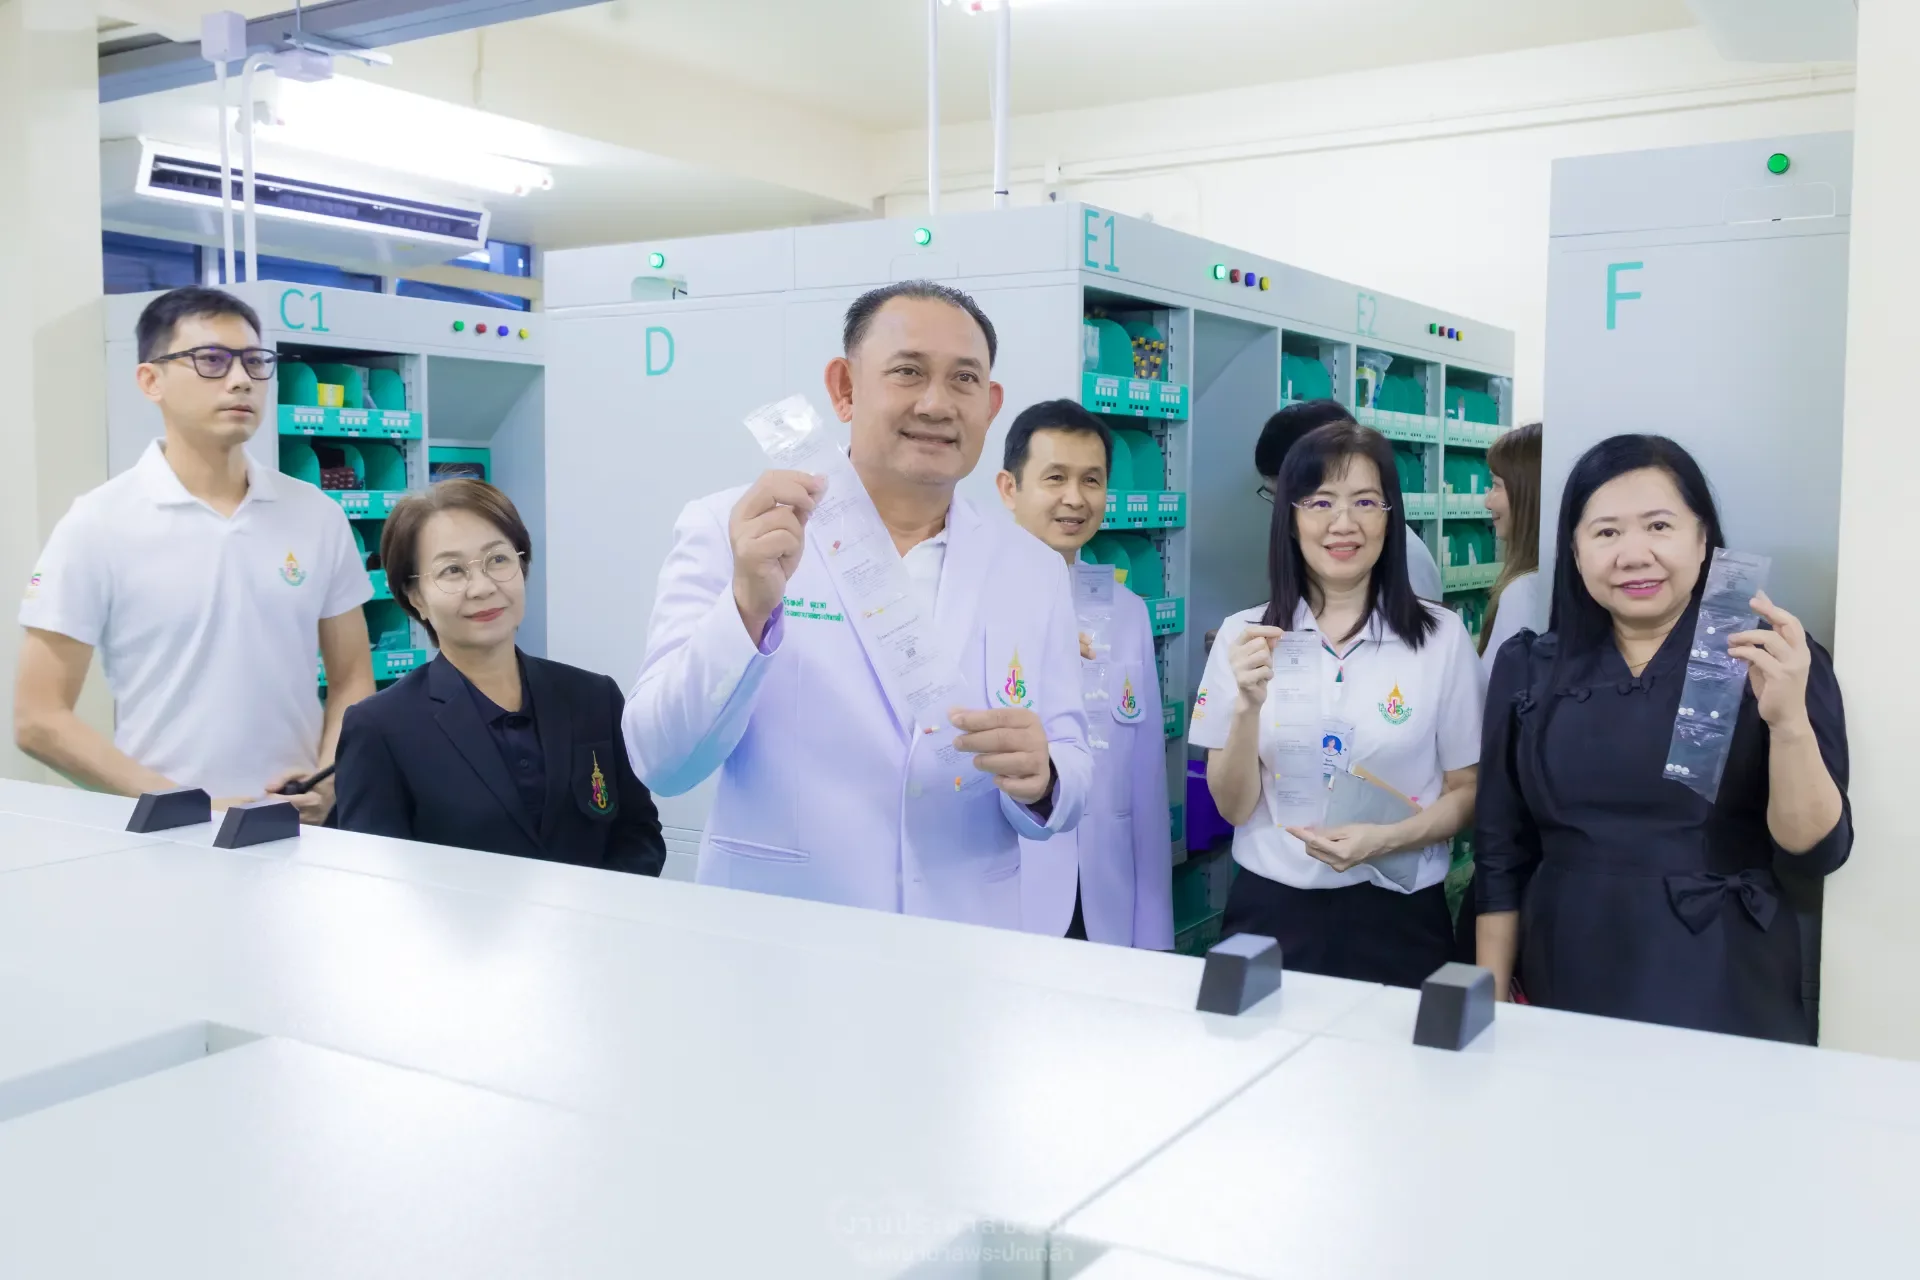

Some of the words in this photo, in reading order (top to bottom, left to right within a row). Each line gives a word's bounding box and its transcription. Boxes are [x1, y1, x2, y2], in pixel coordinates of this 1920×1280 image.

[1083, 208, 1119, 273] E1
[279, 288, 329, 332] C1
[1356, 293, 1378, 336] E2
[1606, 261, 1644, 330] F
[644, 325, 676, 377] D
